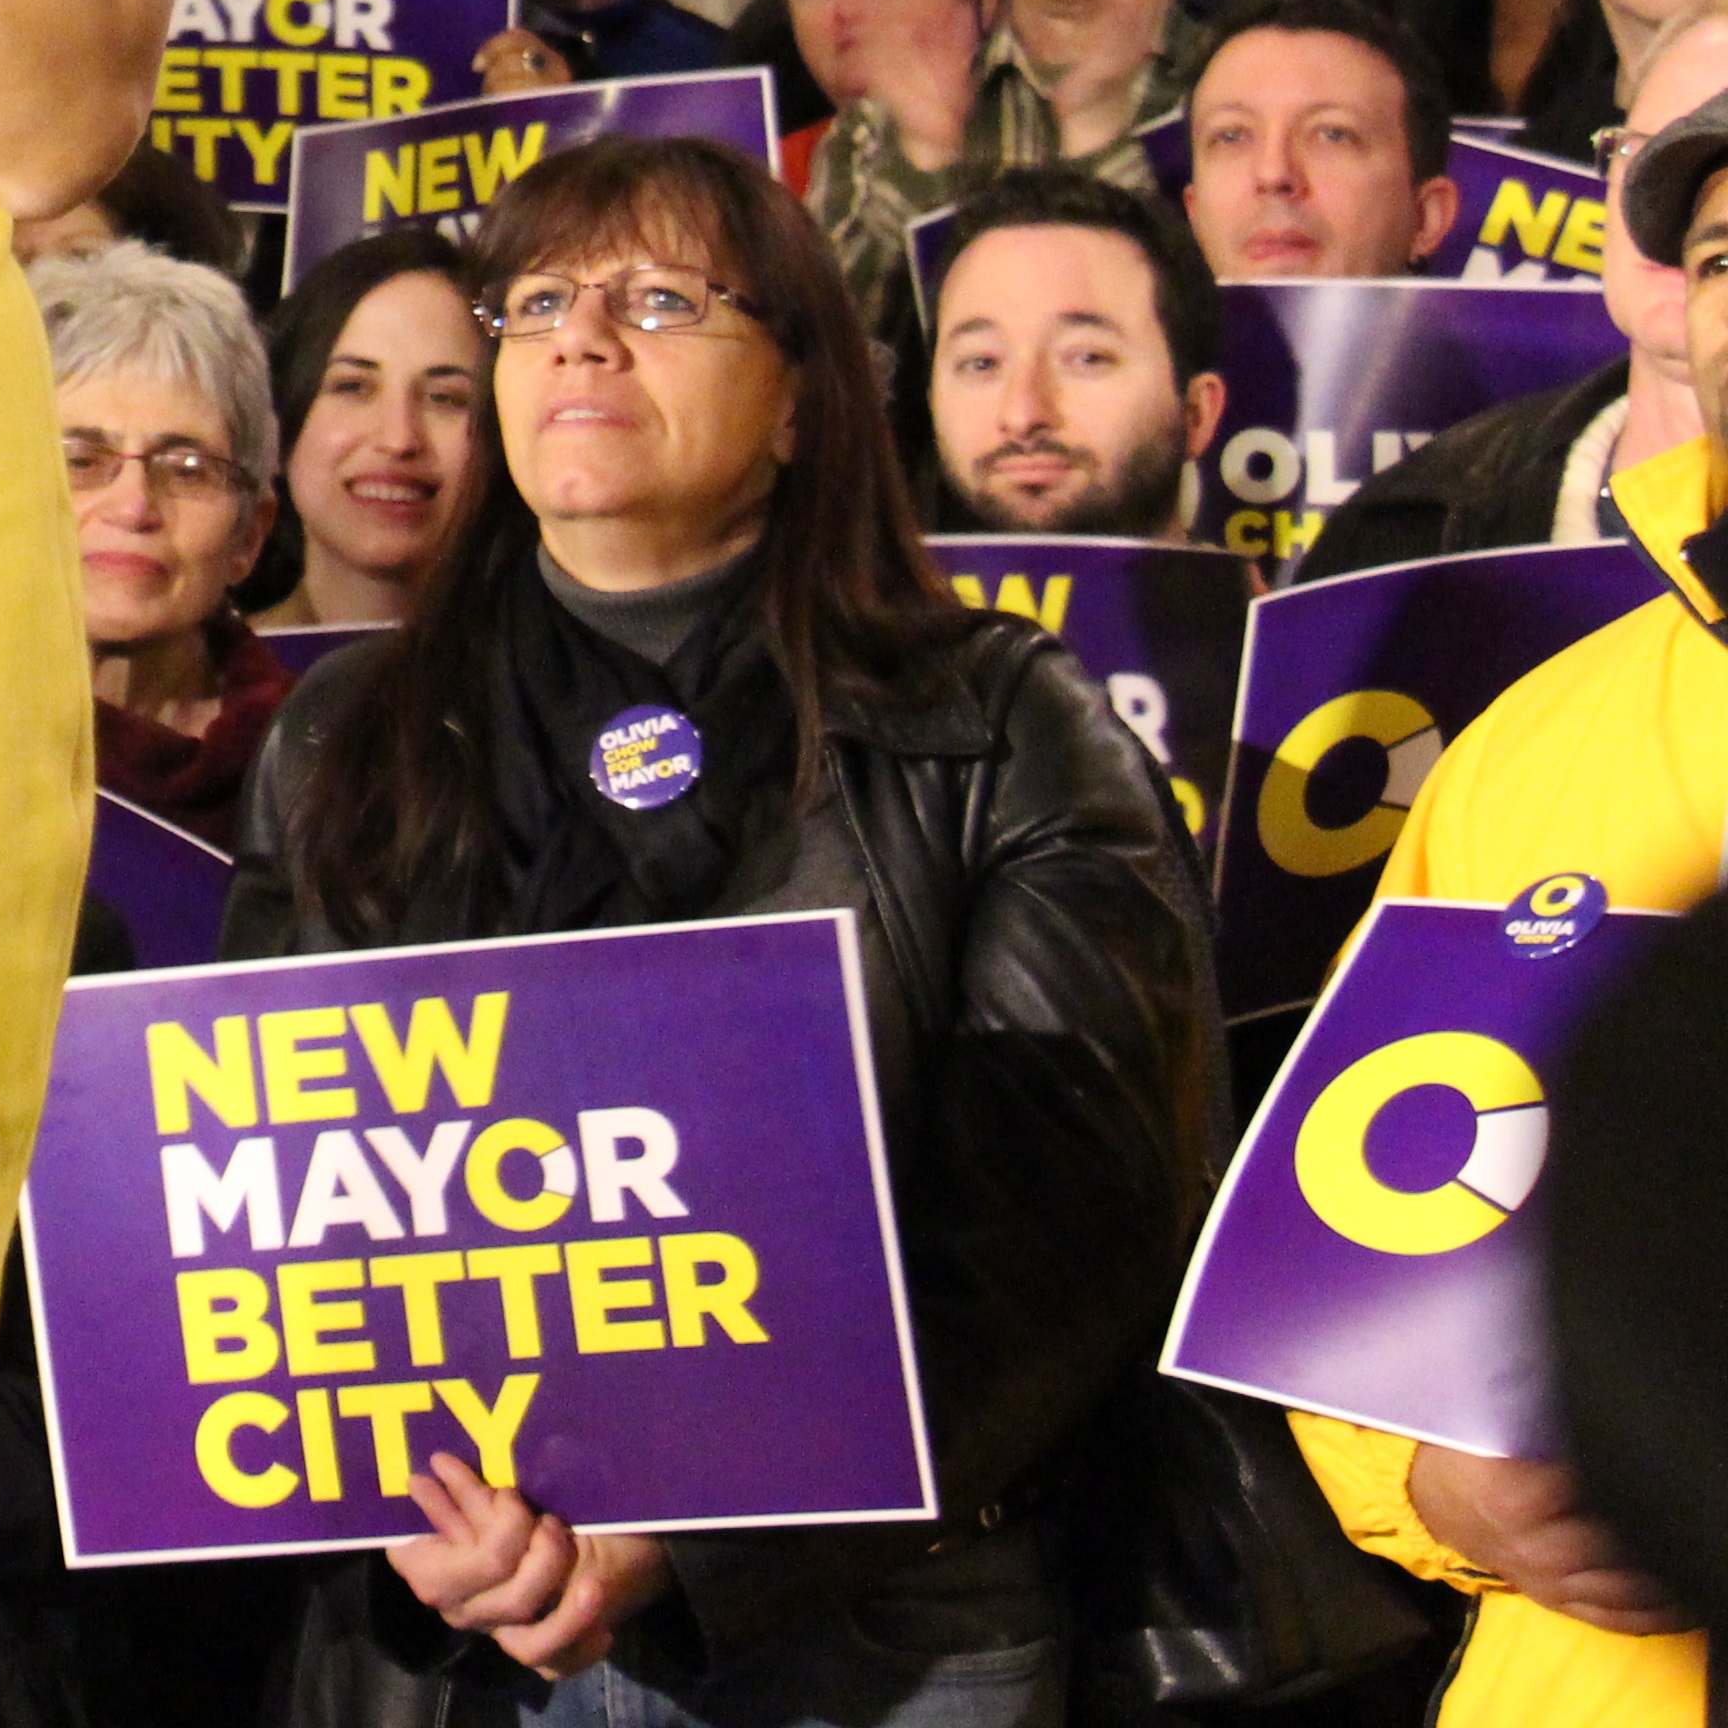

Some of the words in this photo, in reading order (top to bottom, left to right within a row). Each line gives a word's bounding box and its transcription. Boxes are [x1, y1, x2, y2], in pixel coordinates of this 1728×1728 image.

[152, 47, 432, 120] ETTER
[150, 116, 294, 186] ITY
[363, 122, 548, 222] NEW
[1478, 177, 1607, 276] NE
[1224, 508, 1327, 560] CH
[599, 713, 678, 751] OLIVIA
[602, 736, 659, 764] CHOW
[606, 755, 644, 777] FOR
[608, 753, 692, 794] MAYOR
[1505, 920, 1576, 937] OLIVIA
[144, 990, 511, 1136] NEW
[159, 1106, 690, 1259] MAYOR
[175, 1231, 771, 1385] BETTER
[194, 1372, 542, 1510] CITY
